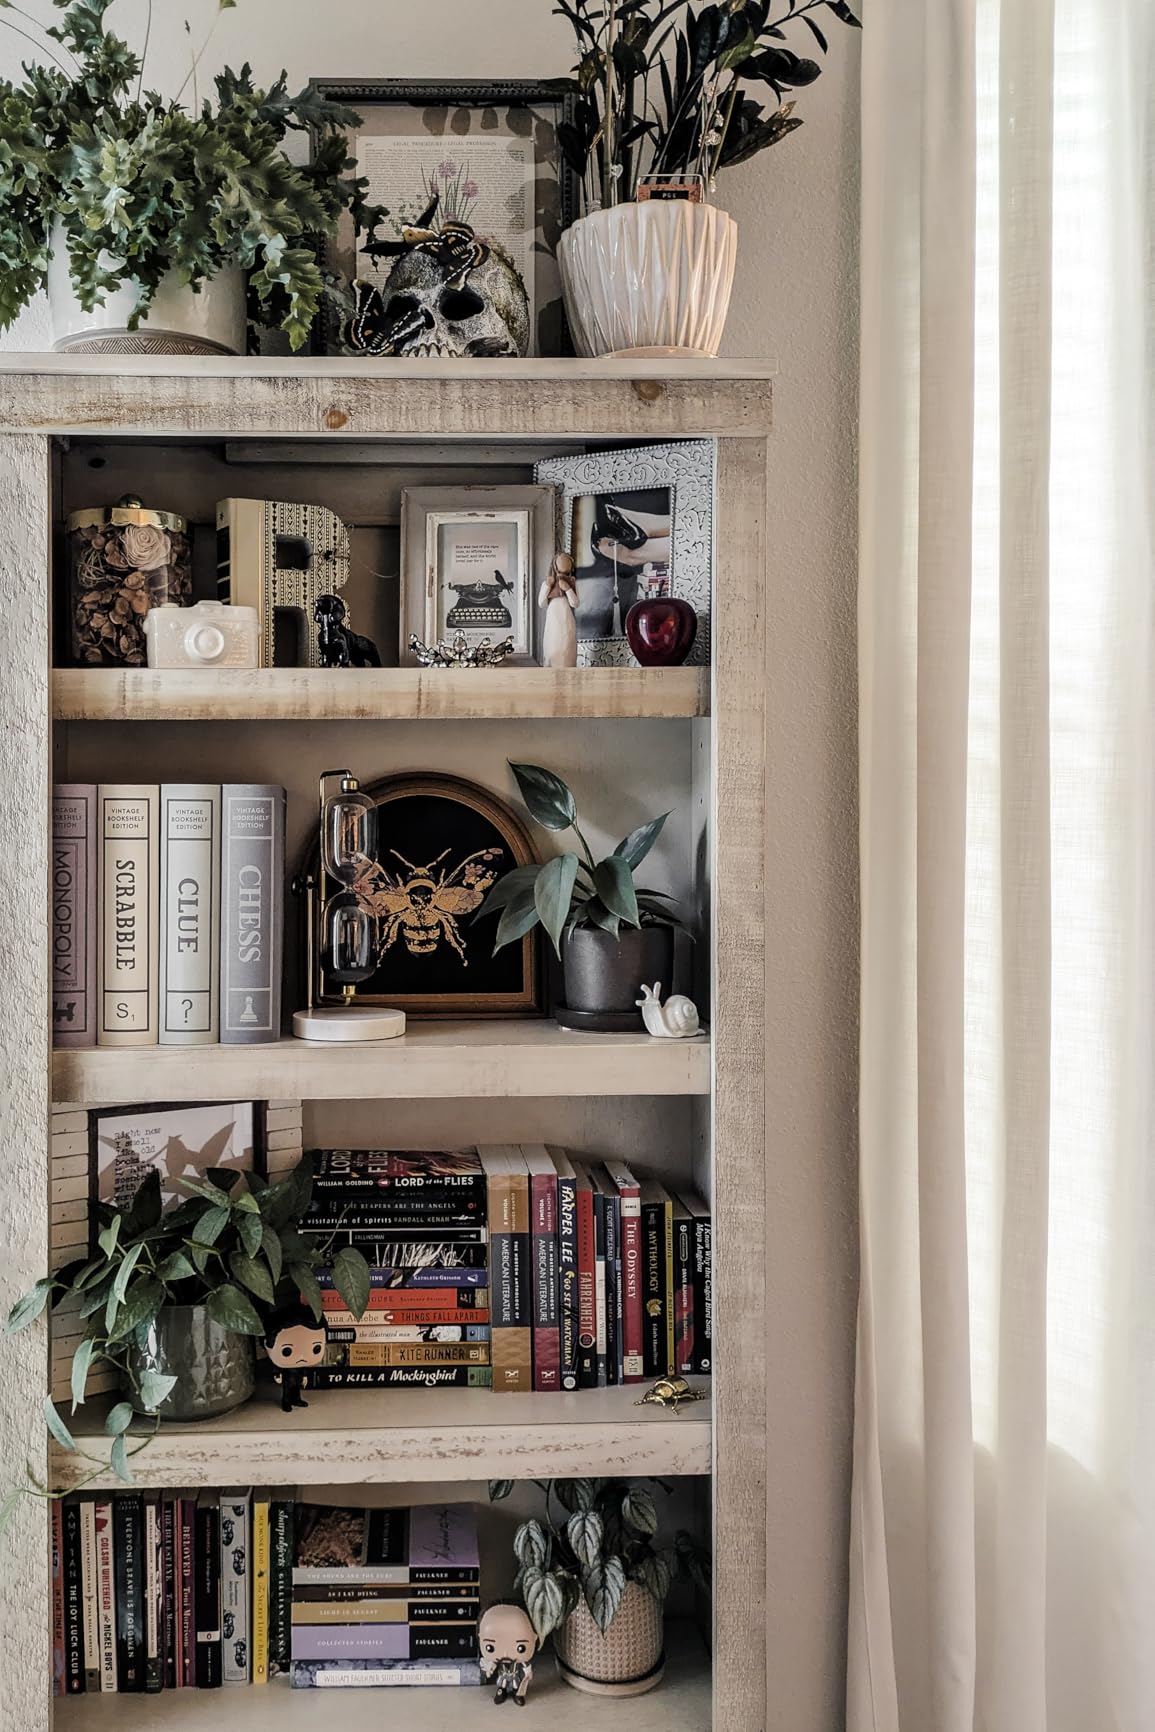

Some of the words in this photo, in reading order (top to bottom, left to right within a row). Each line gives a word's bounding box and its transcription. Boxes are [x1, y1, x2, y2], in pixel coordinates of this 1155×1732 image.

[55, 850, 72, 976] MONOPOLY
[116, 860, 136, 970] SCRABBLE
[178, 878, 199, 952] CLUE
[238, 865, 262, 962] CHESS
[141, 1146, 156, 1154] old
[330, 1151, 352, 1174] LORD
[368, 1151, 388, 1173] FLIES
[395, 1178, 424, 1187] LORD
[444, 1177, 474, 1186] FLIES
[364, 1216, 392, 1225] spirits
[562, 1186, 574, 1236] HARPER
[627, 1222, 637, 1245] THE
[695, 1223, 704, 1244] Maya
[502, 1239, 510, 1279] AMERICAN
[562, 1242, 572, 1263] LEE
[649, 1231, 658, 1292] MYTHOLOGY
[696, 1244, 704, 1273] Angelou
[564, 1278, 571, 1290] GO
[627, 1250, 638, 1298] ODYSSEY
[539, 1281, 548, 1322] LITERATURE
[580, 1272, 592, 1330] FAHRENHEIT
[401, 1313, 430, 1321] THINGS
[433, 1312, 451, 1320] FALL
[454, 1312, 479, 1321] APART
[400, 1349, 422, 1360] KITE
[424, 1349, 464, 1360] RUNNER
[564, 1318, 572, 1366] WATCHMAN
[347, 1374, 373, 1382] KILL
[390, 1369, 457, 1386] Mockingbird
[101, 1537, 109, 1566] COLSON
[102, 1568, 110, 1610] WHITEHEAD
[104, 1624, 112, 1650] NICKEL
[104, 1652, 112, 1671] BOYS
[324, 1674, 349, 1682] WILLIAM
[351, 1674, 380, 1682] FAULKNER
